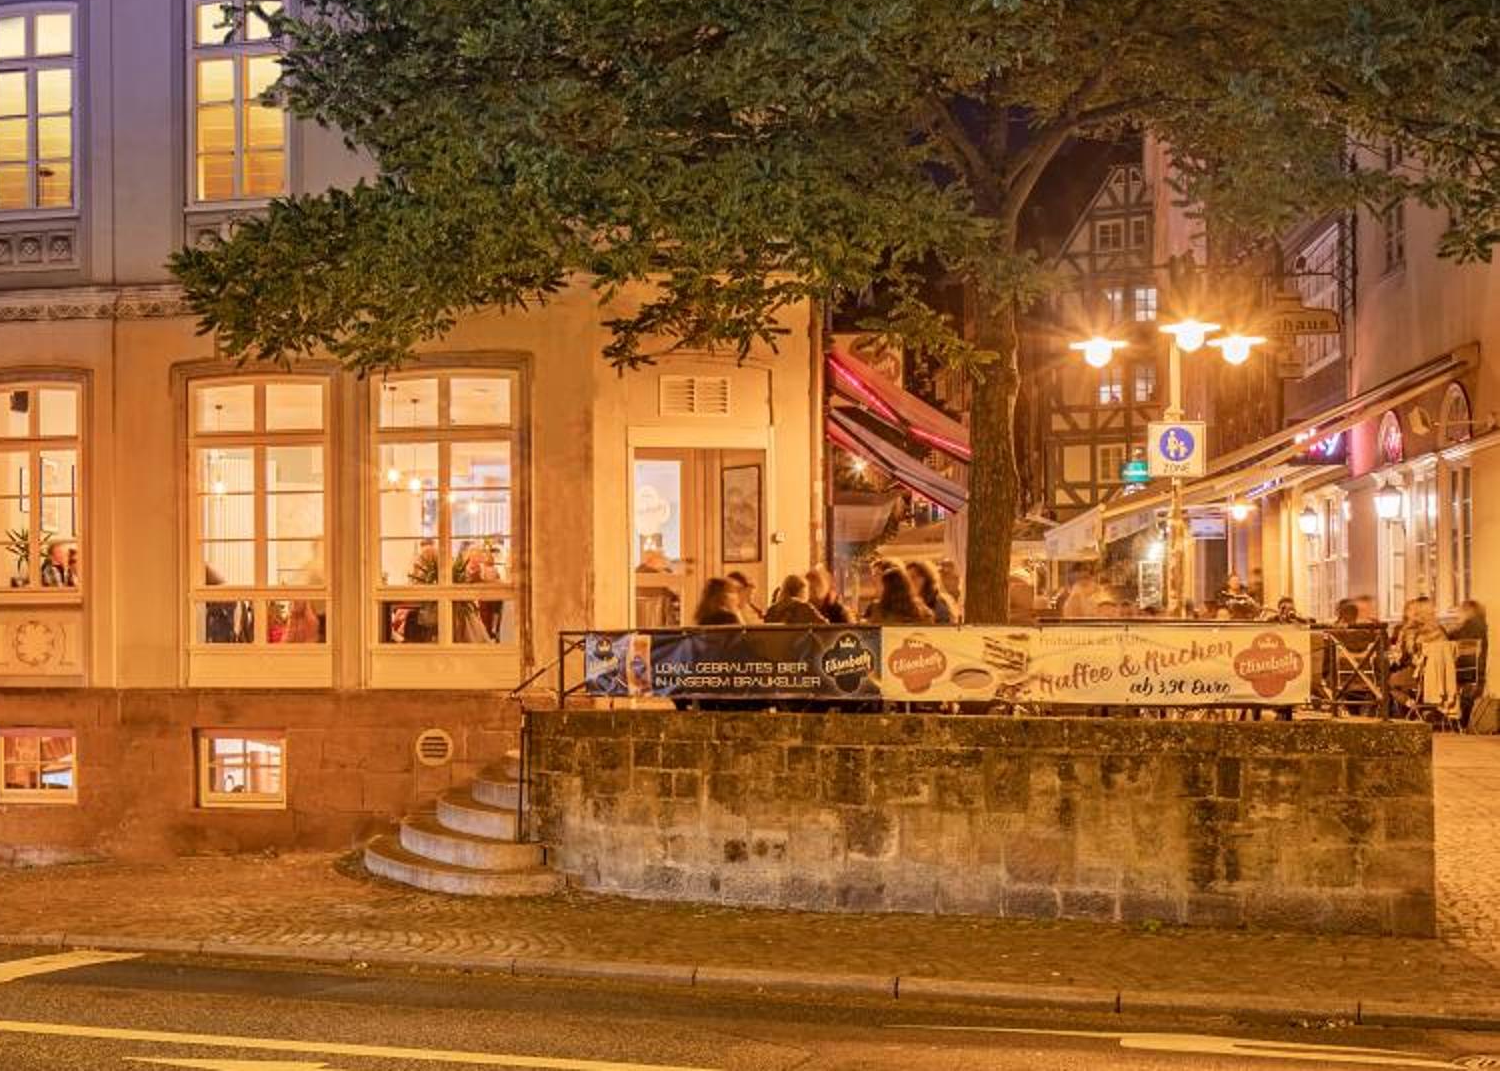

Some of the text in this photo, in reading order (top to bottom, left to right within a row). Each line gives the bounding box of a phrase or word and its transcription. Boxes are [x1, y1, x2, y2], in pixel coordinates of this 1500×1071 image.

[1164, 462, 1190, 473] ZONE
[655, 662, 808, 674] LOKAL GEBRAUTES BIER
[1038, 640, 1233, 695] Kaffee & Kuchen
[1238, 653, 1299, 676] Elisabeth
[655, 677, 821, 688] IN UNSEREM BRAUKELLER
[1130, 677, 1153, 695] ab
[1191, 679, 1230, 695] Euro
